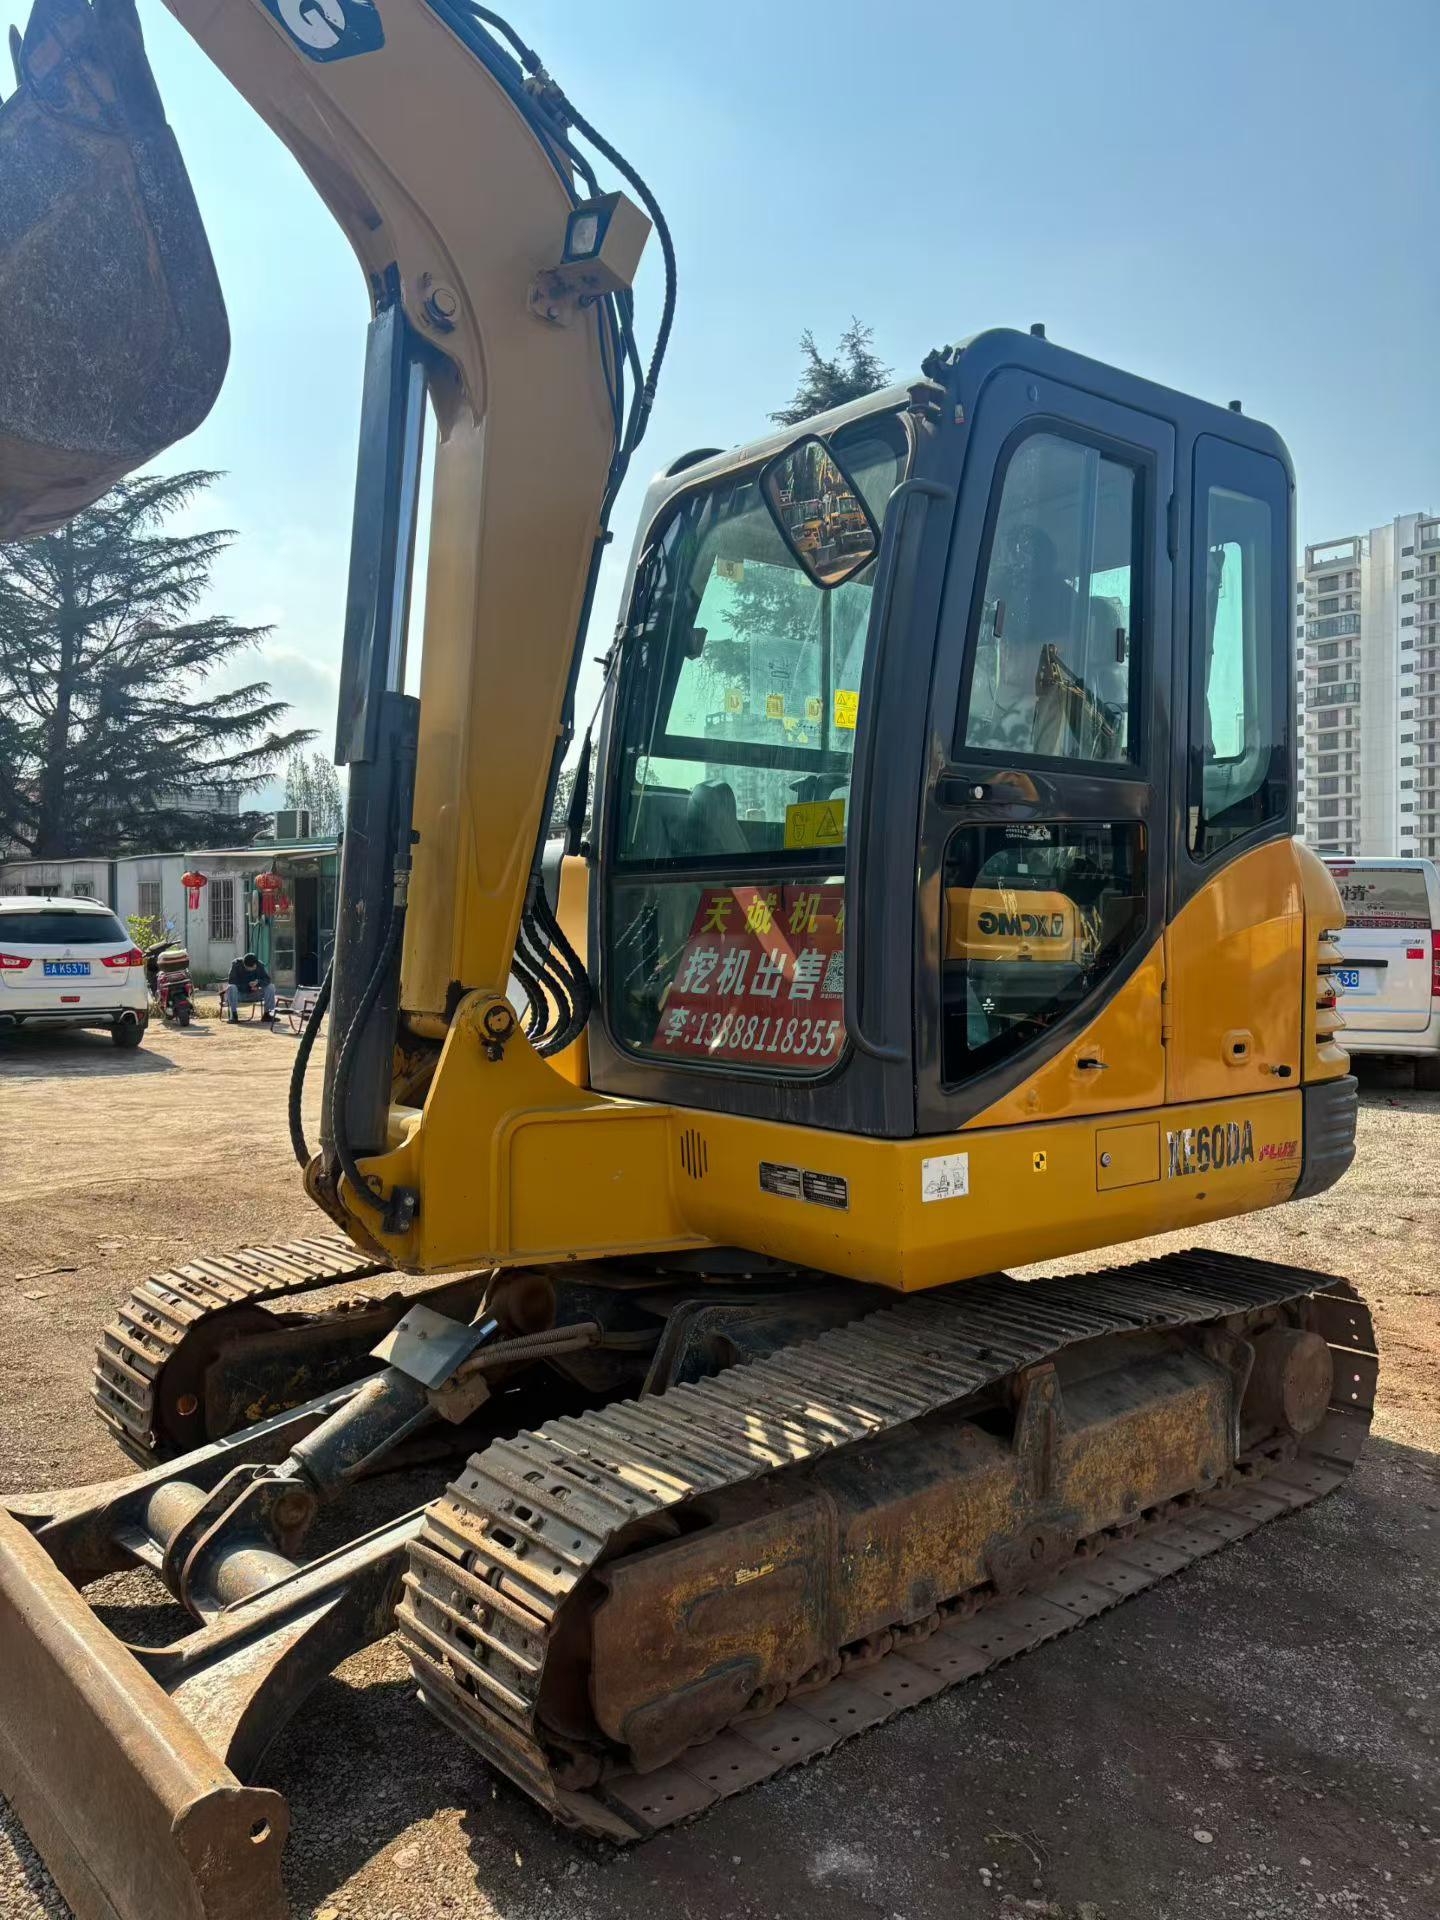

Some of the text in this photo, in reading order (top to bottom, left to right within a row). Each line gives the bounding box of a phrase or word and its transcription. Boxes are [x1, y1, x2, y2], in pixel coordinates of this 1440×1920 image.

[680, 946, 826, 1000] 挖机出售
[1167, 1119, 1255, 1179] XE60DA
